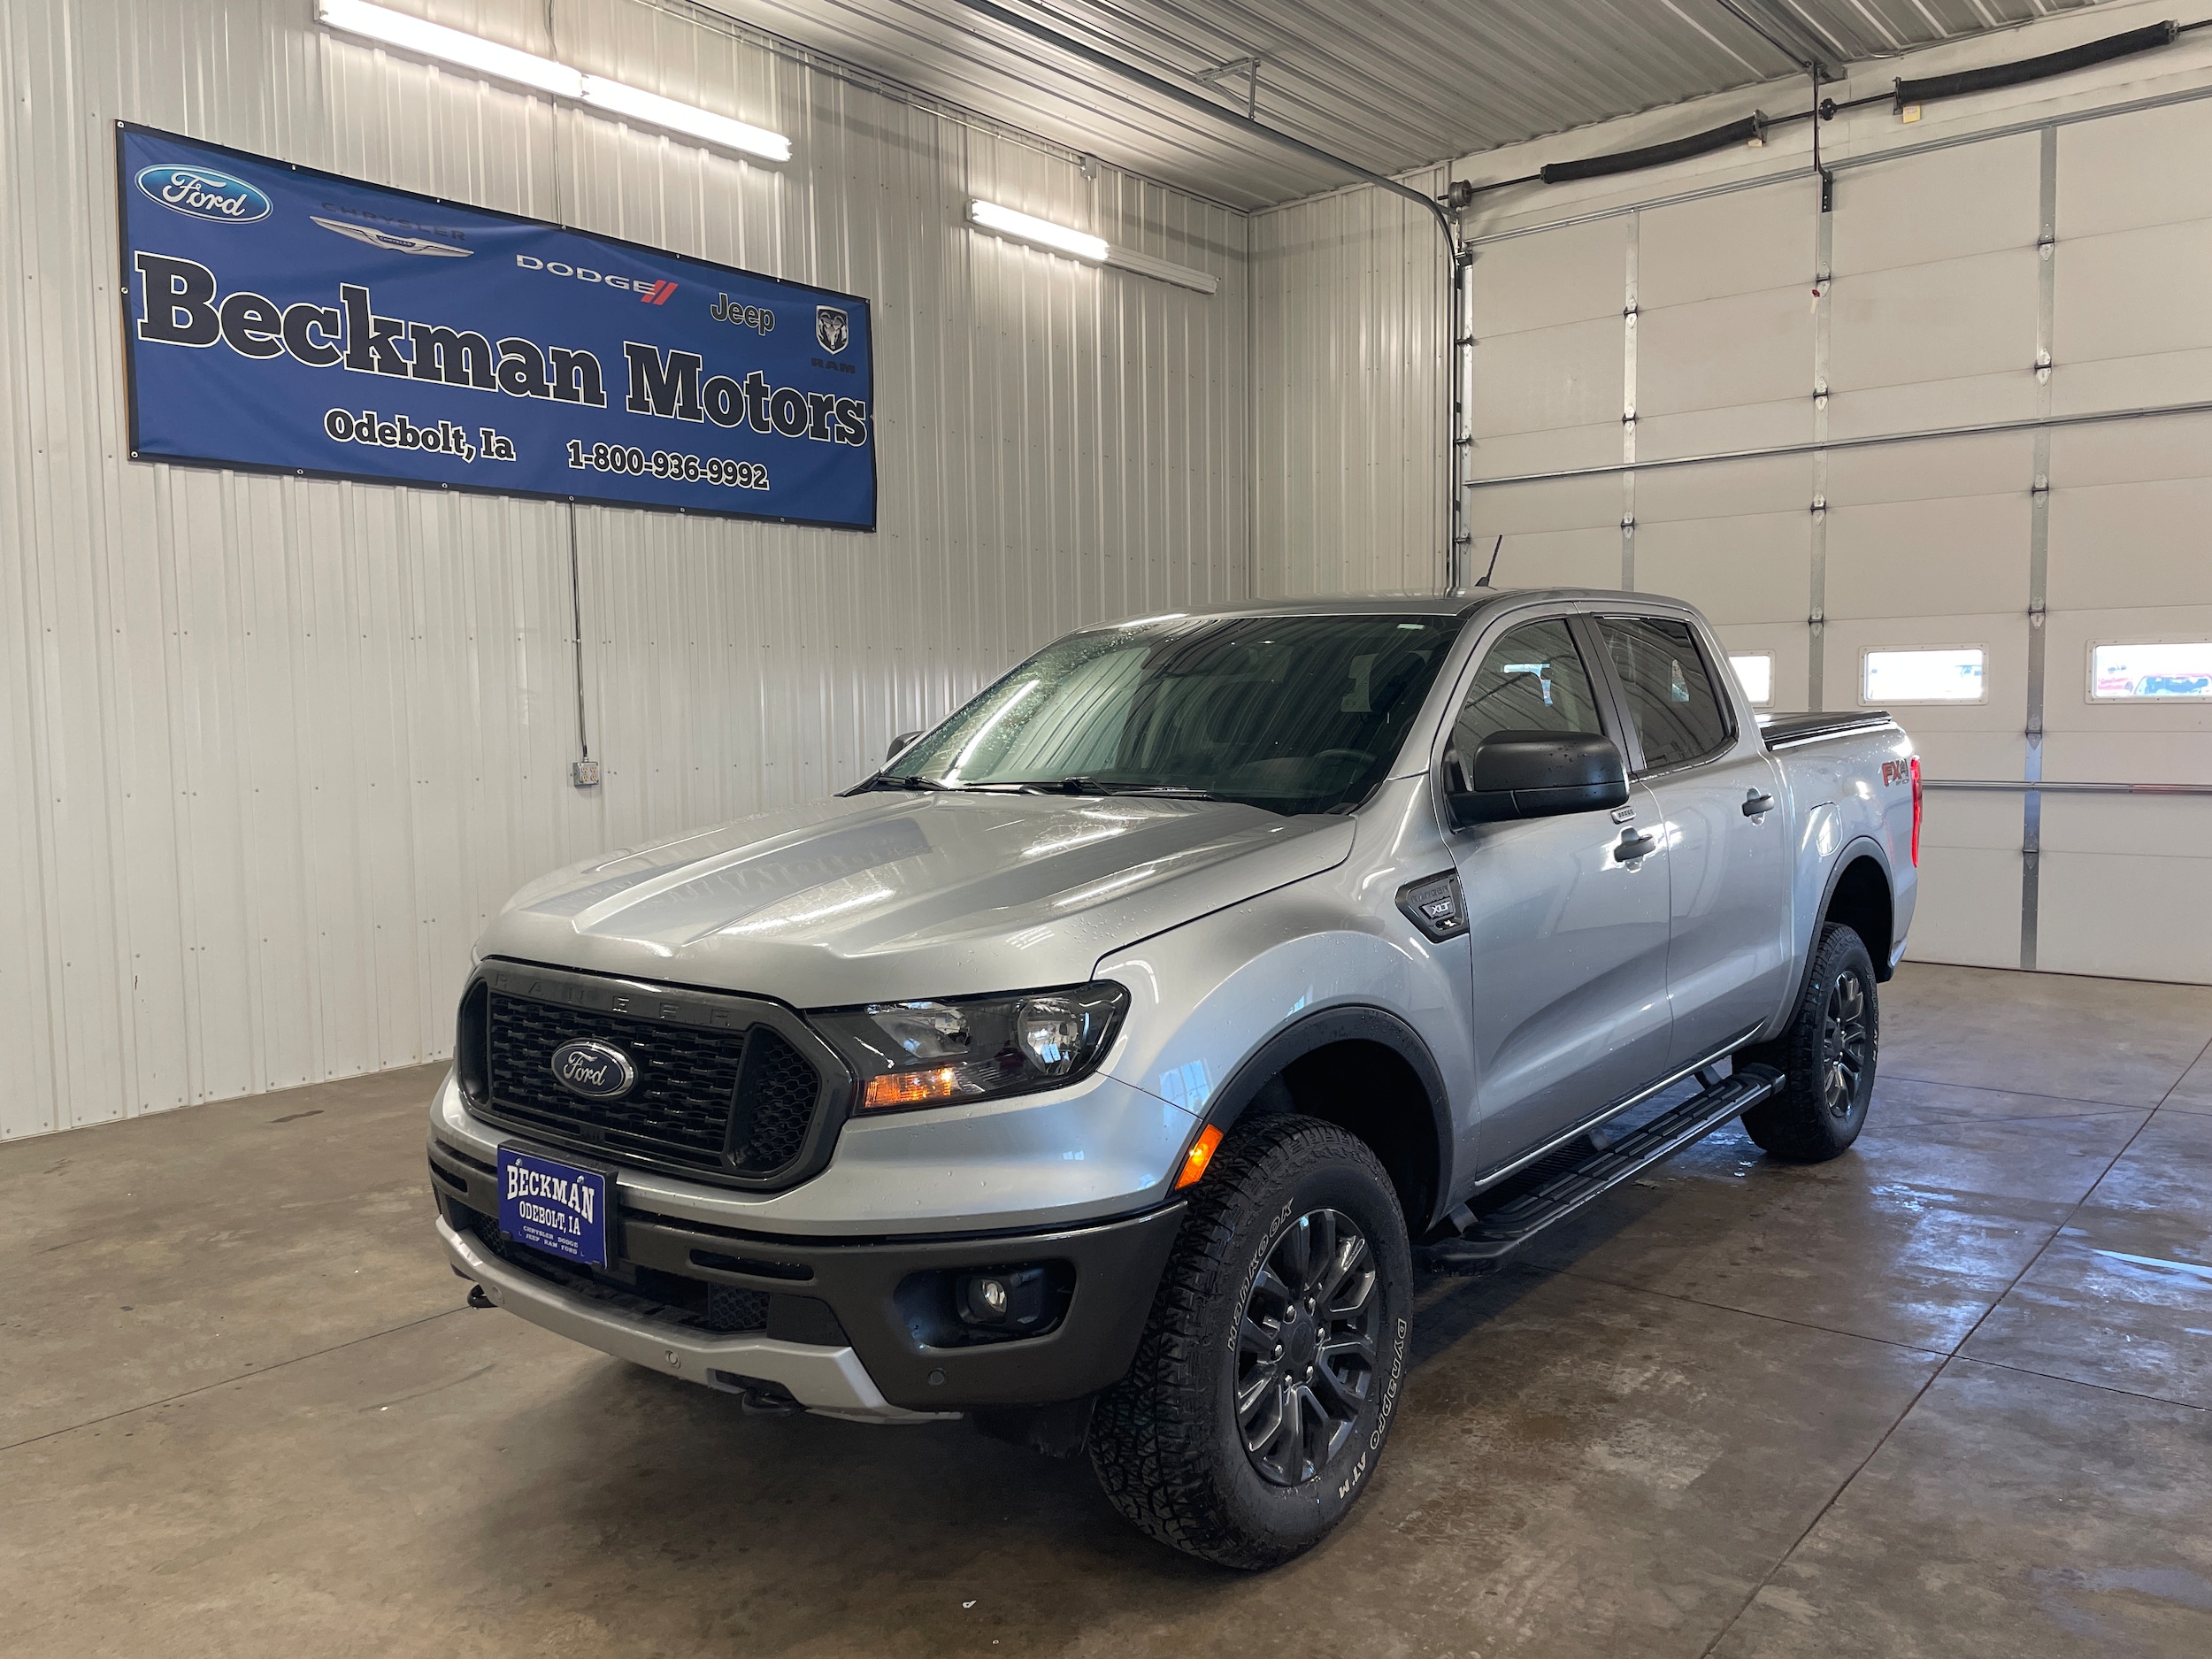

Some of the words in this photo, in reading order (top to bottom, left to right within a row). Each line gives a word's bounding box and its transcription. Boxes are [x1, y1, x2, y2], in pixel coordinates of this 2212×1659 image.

[163, 172, 248, 216] Ford
[321, 203, 466, 241] CHRYSLER
[516, 254, 657, 295] DODGE
[710, 293, 775, 335] Jeep
[134, 250, 607, 408] Beckman
[624, 341, 867, 446] Motors
[811, 357, 856, 374] RAM
[324, 407, 476, 462] Odebolt,
[479, 427, 517, 462] Ia
[567, 440, 770, 490] 1-800-936-9992
[1882, 757, 1909, 787] FX4
[1431, 901, 1451, 915] XLT
[564, 1051, 608, 1087] Ford
[507, 1164, 595, 1225] BECKMAN
[519, 1201, 566, 1233] ODEBOLT,
[568, 1216, 581, 1236] IA
[523, 1225, 554, 1240] CHRYSLER
[557, 1237, 579, 1248] DODGE
[526, 1233, 540, 1242] JEEP
[544, 1240, 557, 1248] RAM
[561, 1245, 578, 1255] FORD
